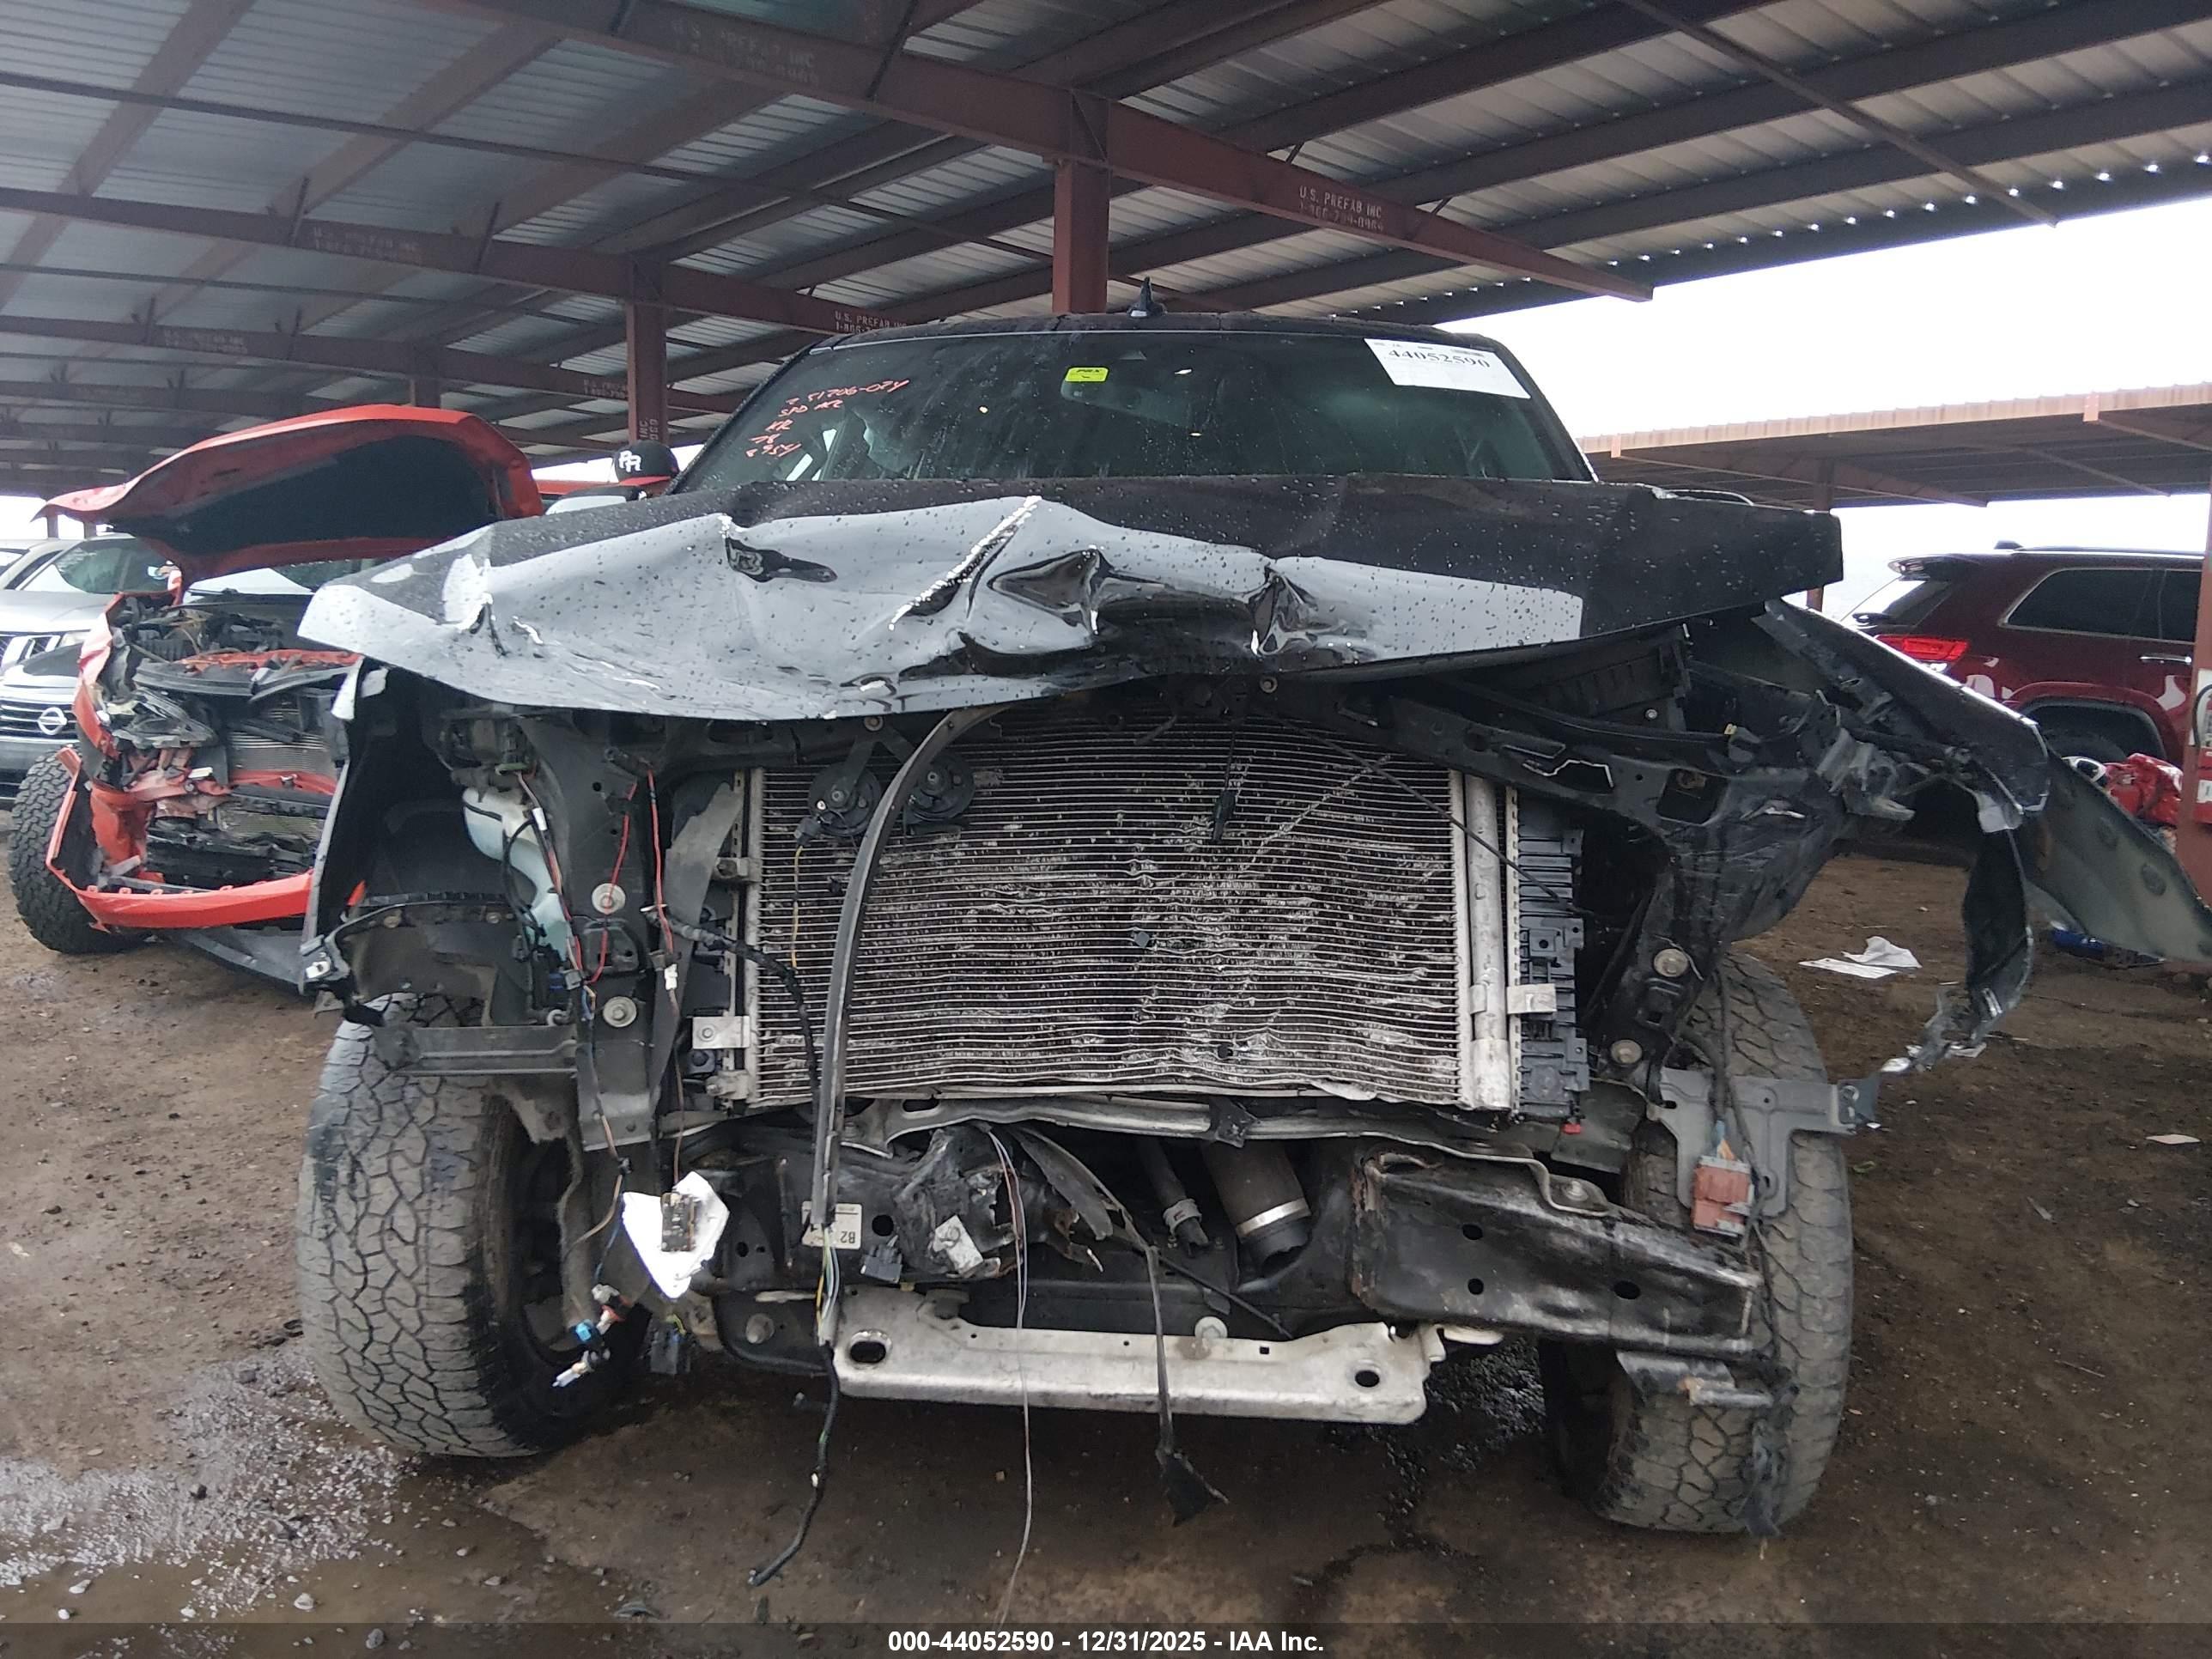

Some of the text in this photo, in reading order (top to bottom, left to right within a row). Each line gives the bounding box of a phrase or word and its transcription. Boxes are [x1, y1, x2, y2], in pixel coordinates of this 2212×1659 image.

[1324, 191, 1364, 215] PREFAB
[1366, 203, 1382, 219] INC
[1389, 349, 1491, 368] 44052590
